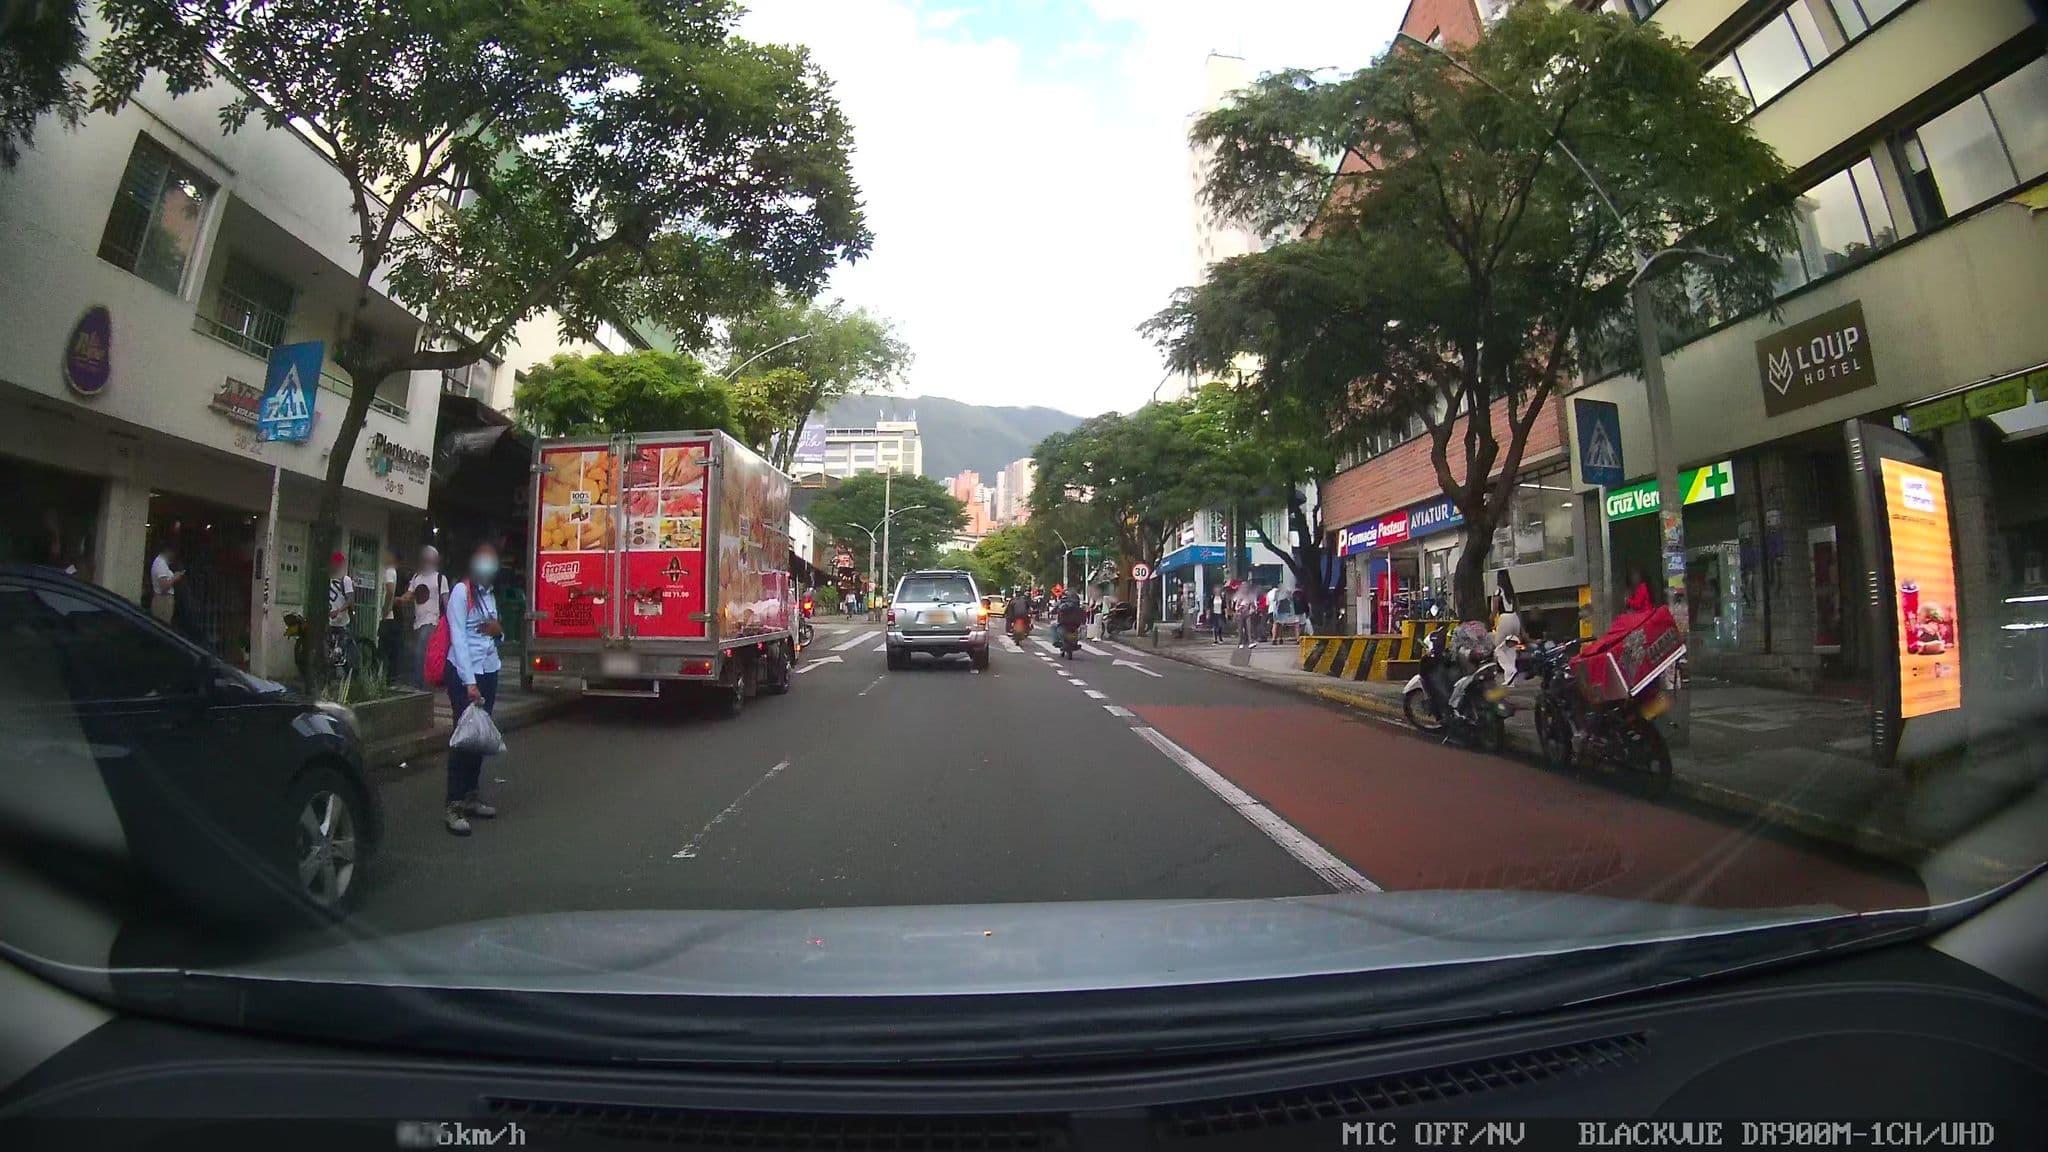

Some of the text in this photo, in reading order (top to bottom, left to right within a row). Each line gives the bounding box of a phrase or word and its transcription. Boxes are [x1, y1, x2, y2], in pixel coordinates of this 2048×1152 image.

[1796, 326, 1859, 370] LOUP
[1804, 358, 1861, 386] HOTEL
[1410, 503, 1449, 530] AVIATUR
[1606, 489, 1660, 517] Cruz Ver
[1348, 525, 1377, 547] Farmacia
[1378, 519, 1407, 538] Pasteur
[541, 561, 580, 578] frozen
[1135, 567, 1147, 577] 30
